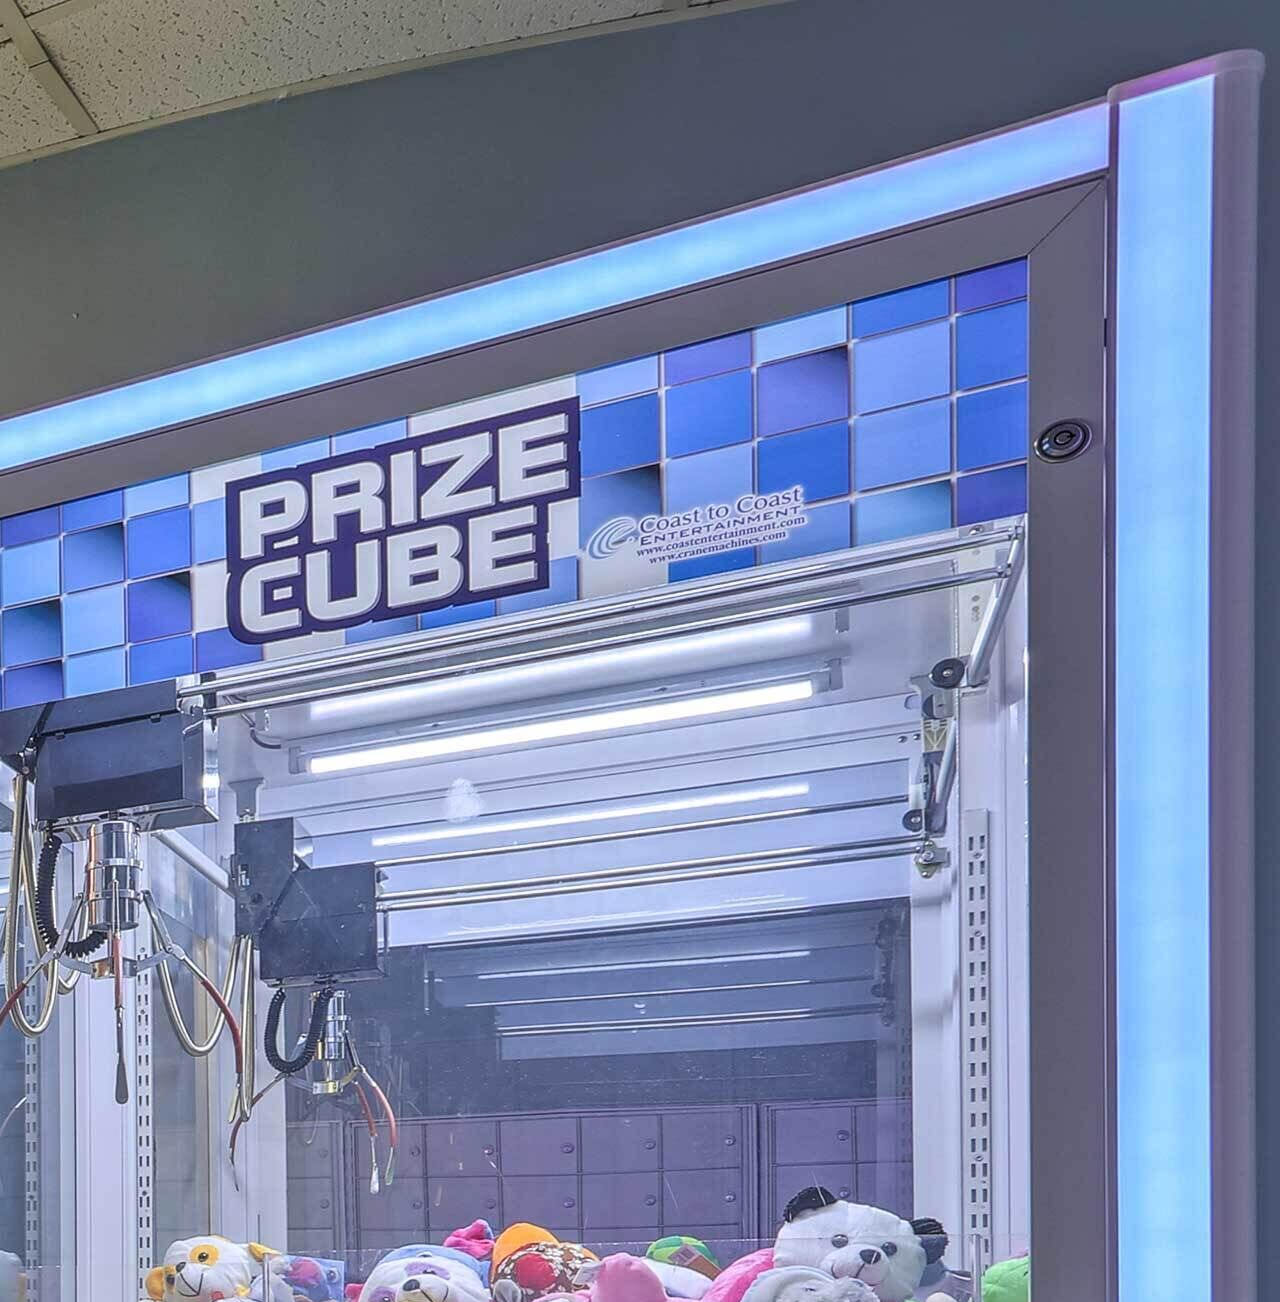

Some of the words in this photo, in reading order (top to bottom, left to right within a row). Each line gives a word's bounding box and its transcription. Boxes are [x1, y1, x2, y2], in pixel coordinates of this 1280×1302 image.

[240, 413, 568, 561] PRIZE
[640, 508, 700, 534] Coast
[708, 504, 729, 519] to
[736, 486, 803, 514] Coast
[640, 505, 801, 546] ENTERTAINMENT
[637, 517, 805, 557] www.coastentertainment.com
[649, 530, 786, 564] www.cranemachines.com
[240, 504, 538, 634] CUBE
